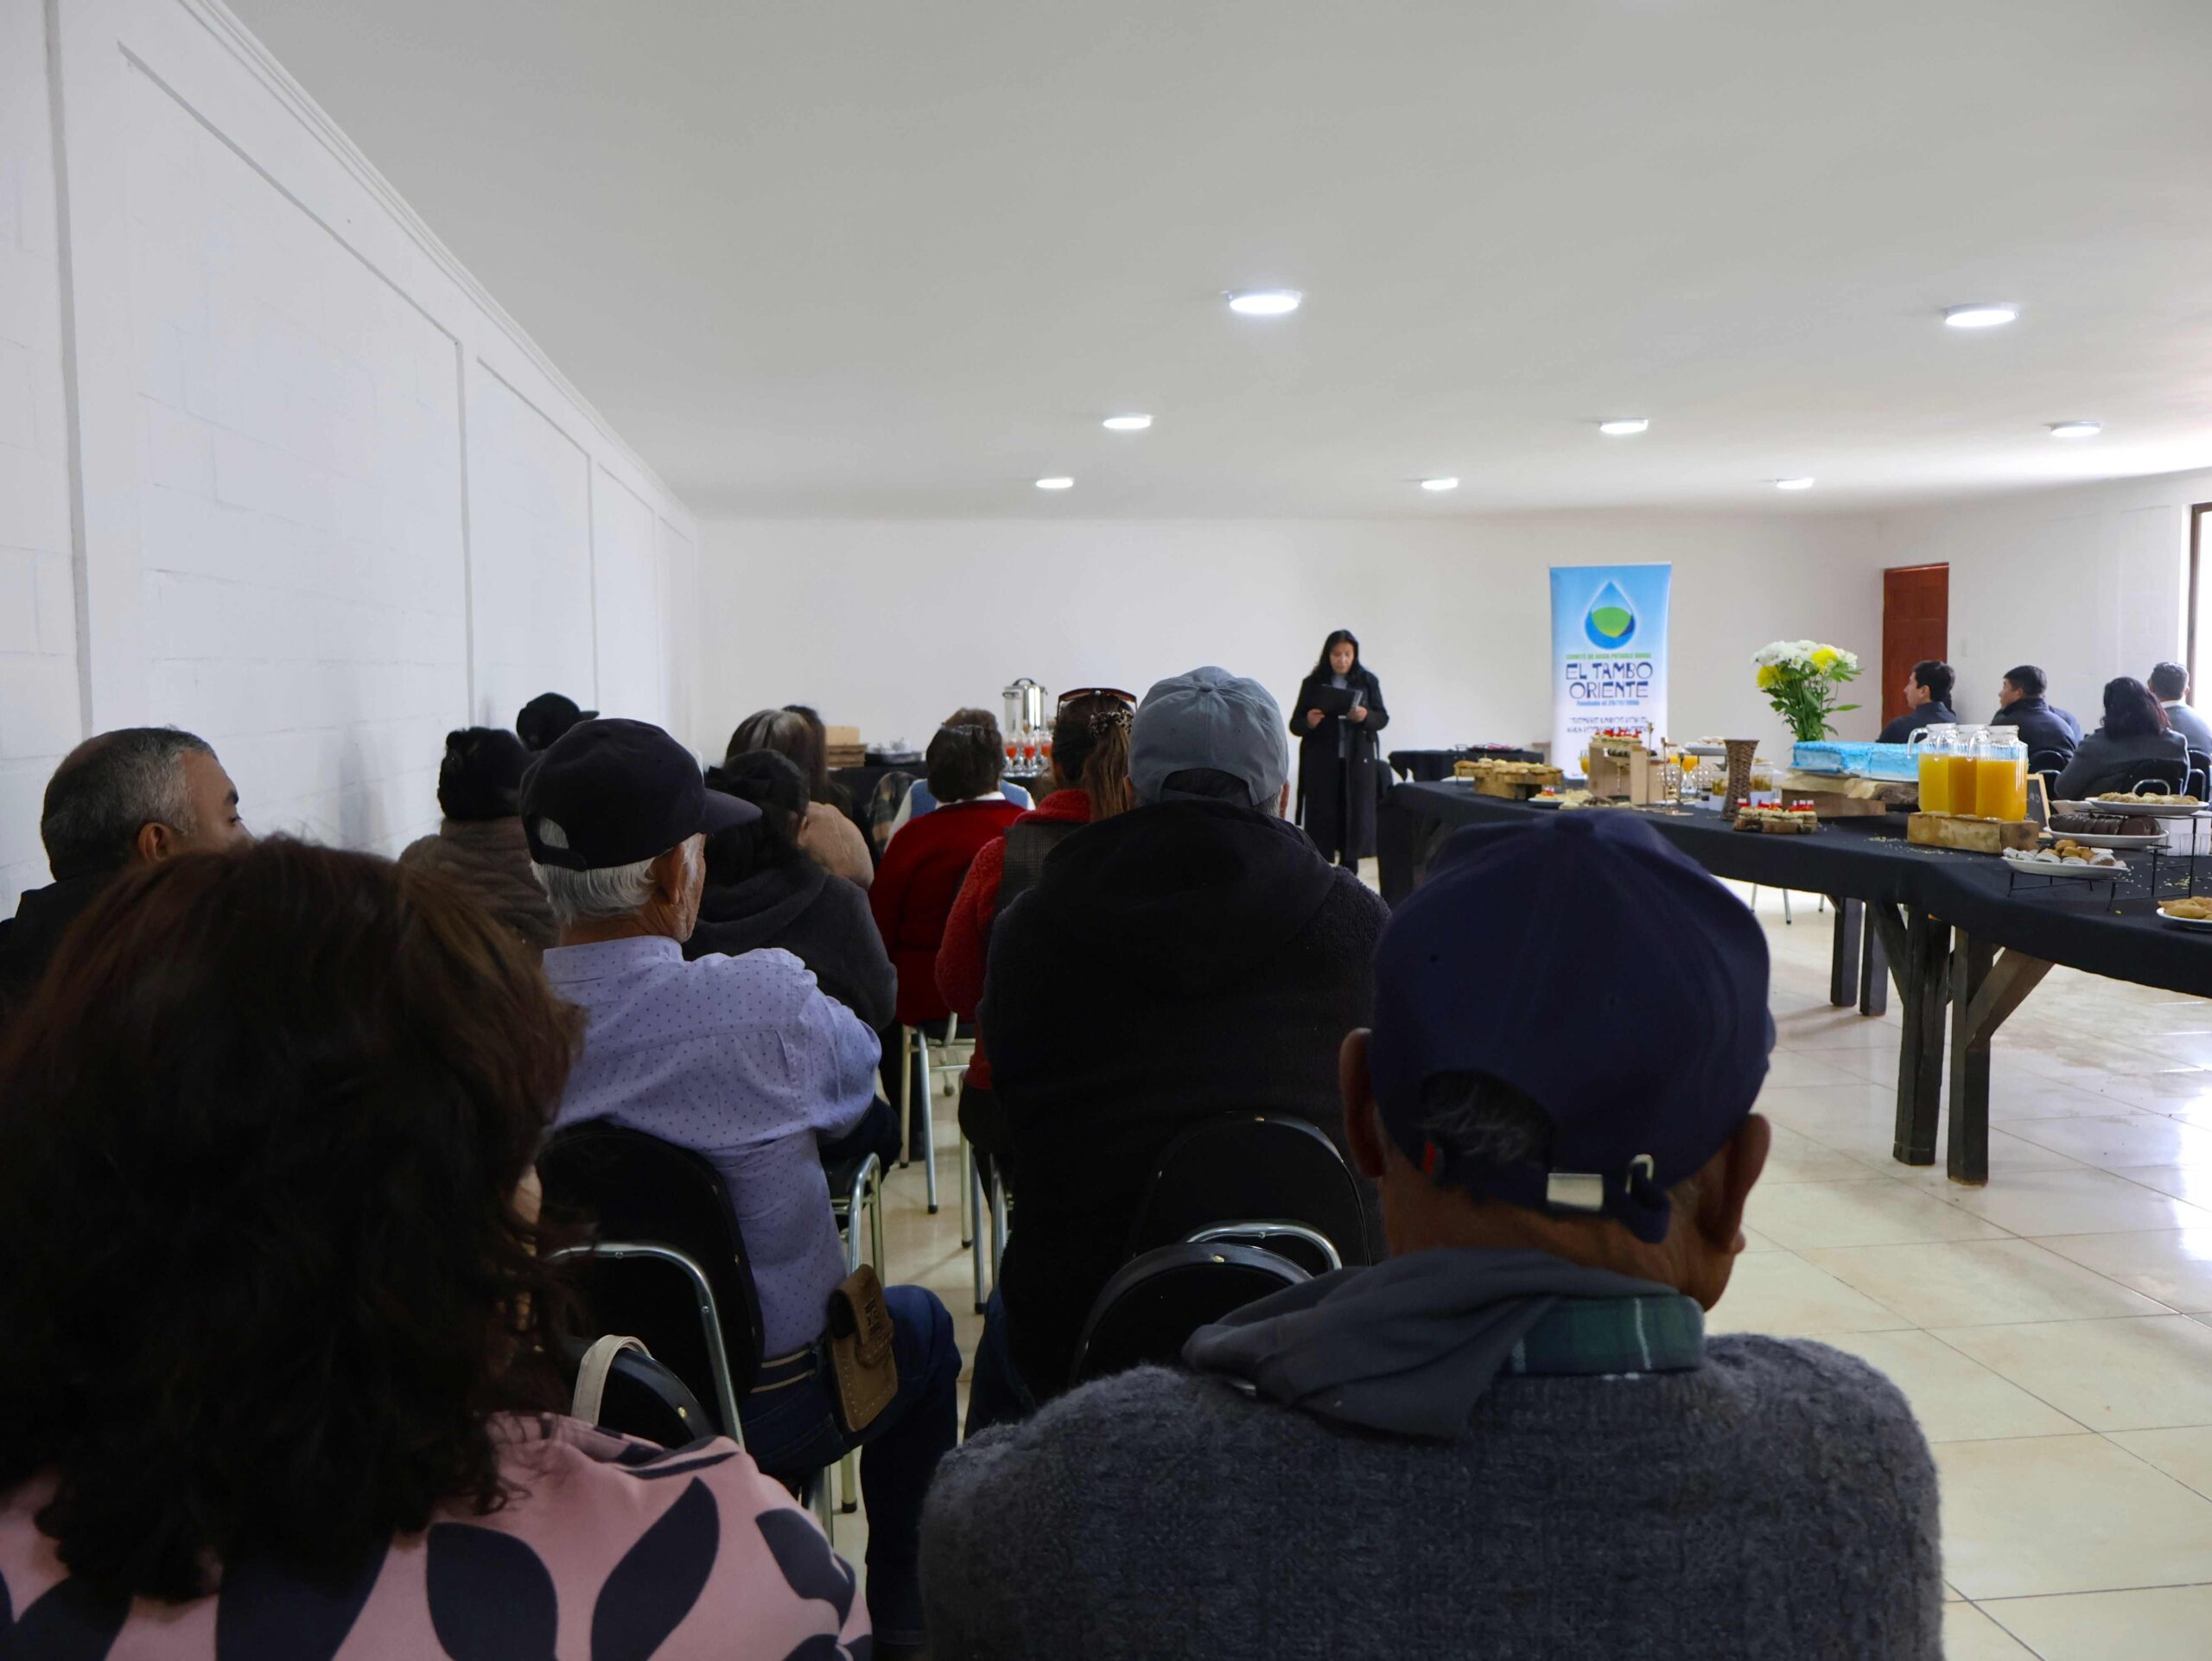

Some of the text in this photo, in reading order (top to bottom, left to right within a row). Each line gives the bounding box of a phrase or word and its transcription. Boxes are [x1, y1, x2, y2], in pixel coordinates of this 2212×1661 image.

[1566, 661, 1653, 680] EL TAMBO
[1569, 681, 1649, 699] ORIENTE
